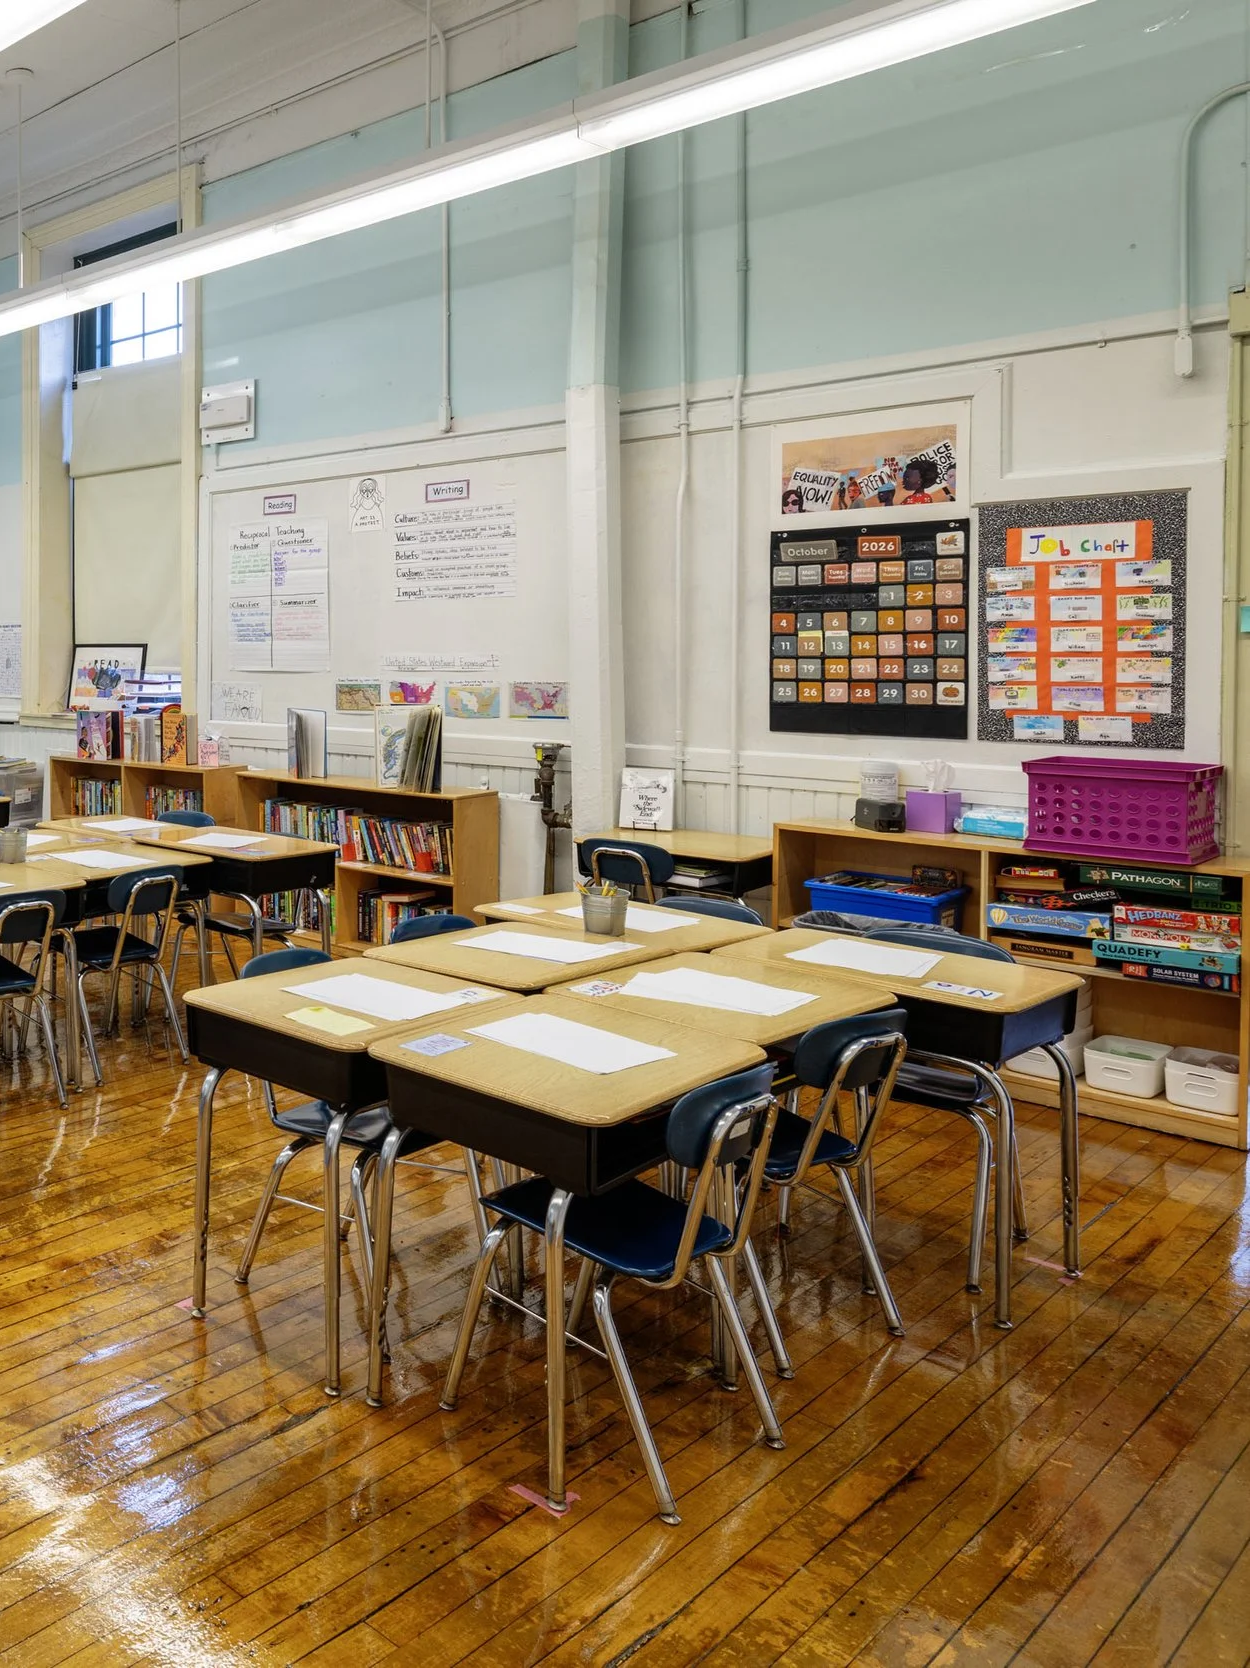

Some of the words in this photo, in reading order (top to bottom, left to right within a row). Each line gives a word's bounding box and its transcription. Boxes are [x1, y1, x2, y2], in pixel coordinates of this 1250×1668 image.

[793, 471, 838, 487] EQUALITY
[432, 485, 464, 496] Writing
[796, 486, 833, 505] NOW!
[268, 501, 292, 510] Reading
[240, 526, 270, 542] Reciprocal
[276, 525, 305, 538] Teaching
[788, 547, 828, 557] October
[862, 542, 895, 552] 2026
[1080, 540, 1130, 553] Chart
[889, 592, 894, 600] 1
[915, 591, 924, 600] 2
[945, 590, 952, 598] 3
[780, 619, 787, 628] 4
[806, 618, 813, 627] 5
[832, 618, 838, 626] 6
[860, 618, 868, 626] 7
[888, 616, 894, 626] 8
[915, 616, 922, 624] 9
[944, 616, 958, 624] 10
[780, 642, 790, 650] 11
[803, 642, 814, 650] 12
[832, 642, 844, 650] 13
[858, 641, 870, 650] 14
[884, 640, 896, 649] 15
[913, 640, 927, 648] 16
[944, 640, 958, 648] 17
[94, 660, 120, 669] READ
[385, 656, 406, 666] United
[408, 656, 428, 666] States
[428, 656, 456, 667] Westward
[459, 656, 488, 667] Expansion
[778, 664, 790, 672] 18
[802, 664, 814, 673] 19
[830, 664, 844, 673] 20
[858, 664, 870, 672] 21
[884, 664, 898, 673] 22
[913, 664, 928, 673] 23
[942, 664, 958, 673] 24
[778, 688, 792, 696] 25
[804, 688, 818, 697] 26
[830, 688, 842, 697] 27
[856, 688, 870, 697] 28
[882, 688, 898, 698] 29
[911, 690, 928, 698] 30
[638, 794, 658, 802] Where
[1111, 872, 1180, 886] PATHAGON
[1072, 890, 1116, 901] Checkers
[1127, 910, 1182, 922] HEDBANZ
[1131, 929, 1191, 944] MONOPOLY
[1097, 943, 1162, 958] QUADEFY
[1174, 970, 1199, 979] SYSTEM
